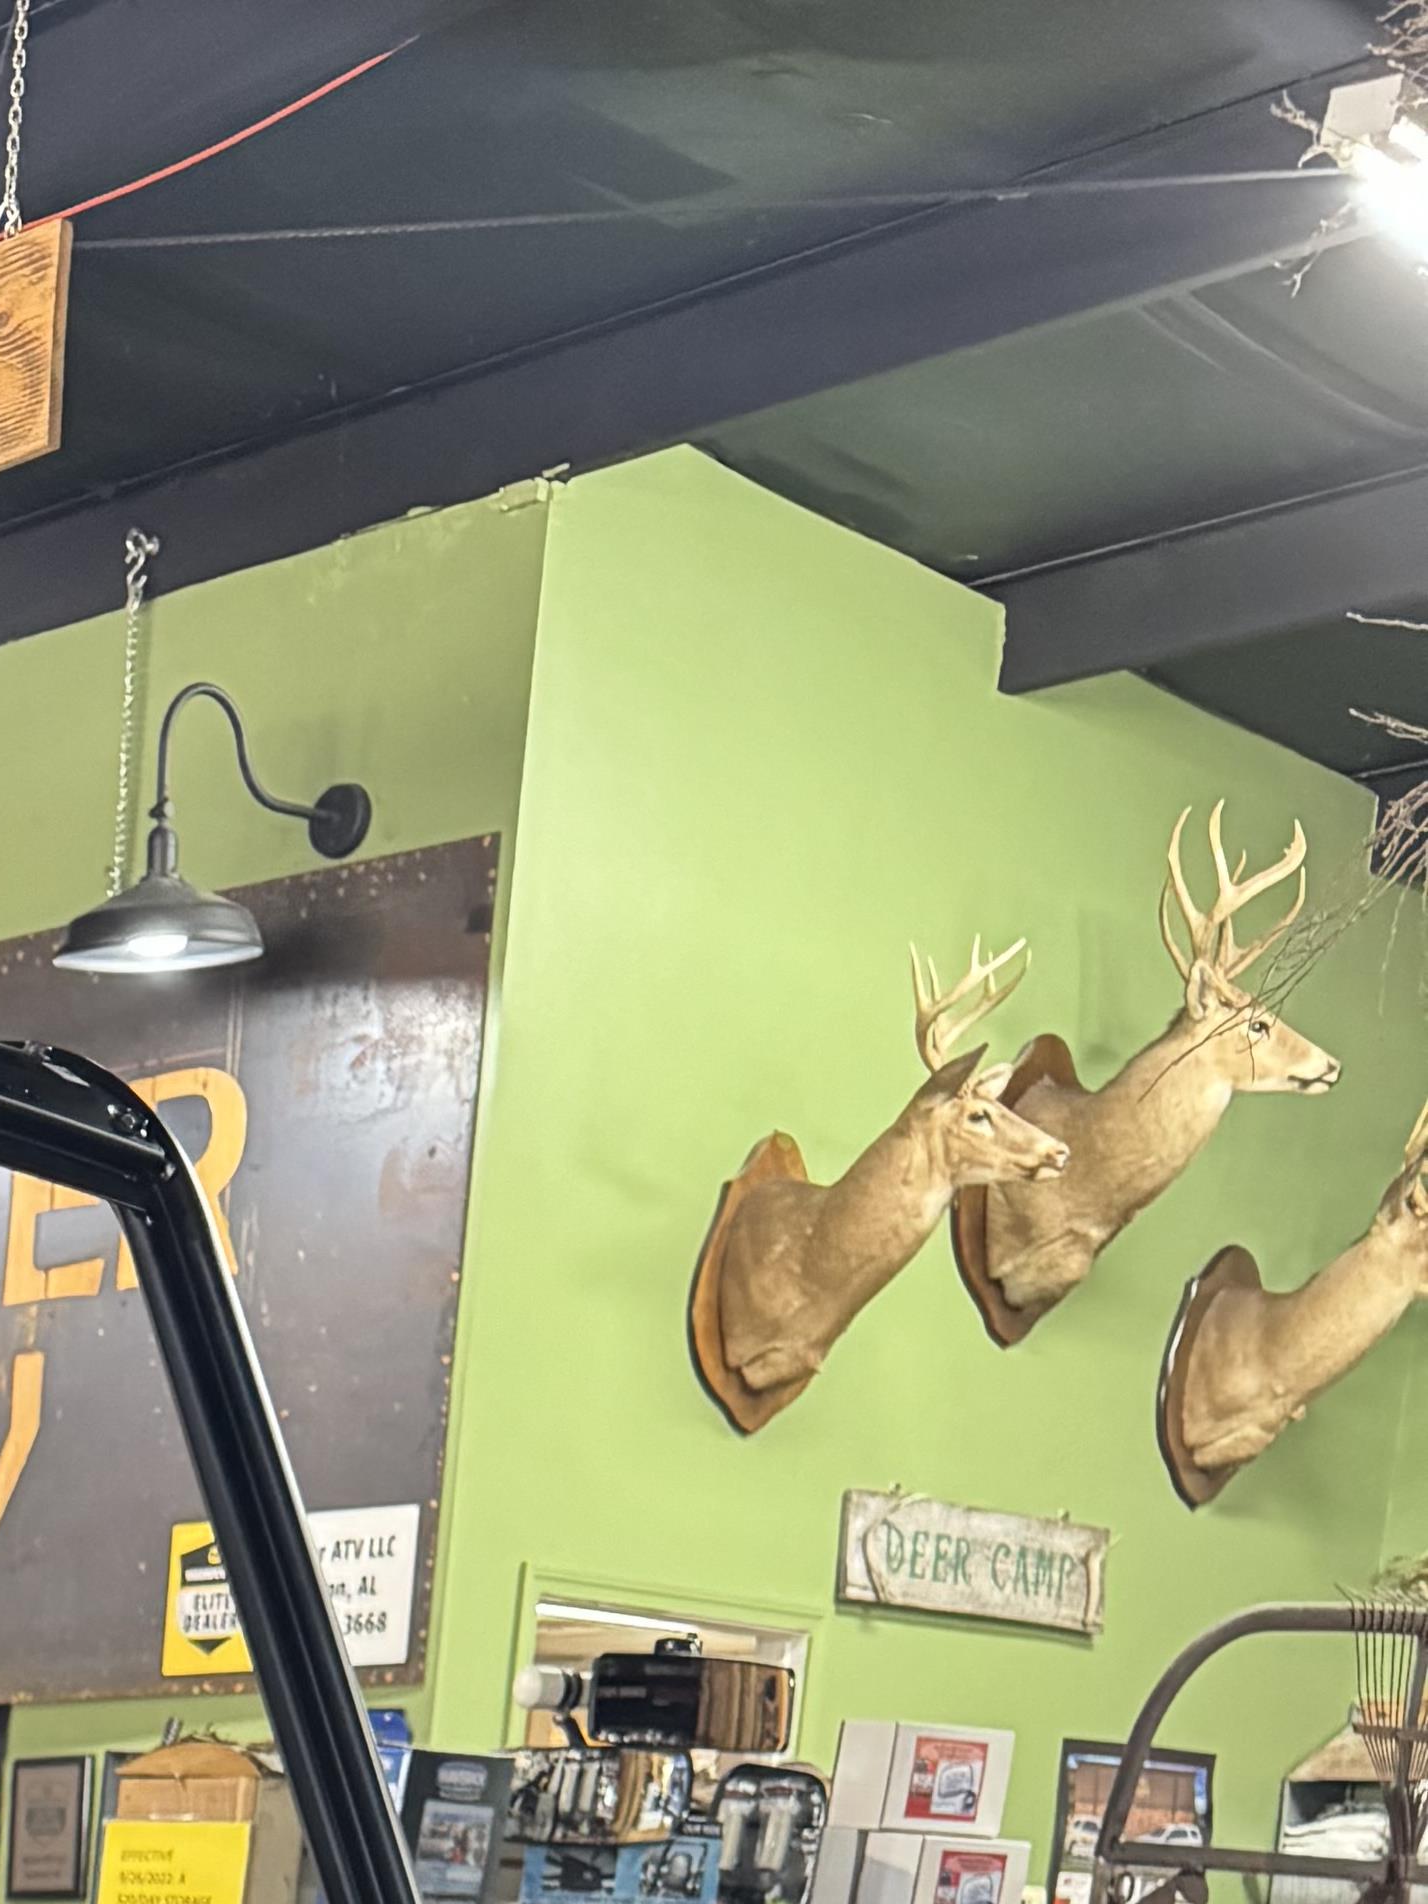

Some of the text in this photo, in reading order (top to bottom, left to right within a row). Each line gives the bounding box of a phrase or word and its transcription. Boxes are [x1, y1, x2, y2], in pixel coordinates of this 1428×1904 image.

[330, 1538, 365, 1562] ATV
[367, 1535, 397, 1559] LLC
[881, 1517, 1078, 1602] DEER CAMP
[357, 1575, 377, 1597] AL
